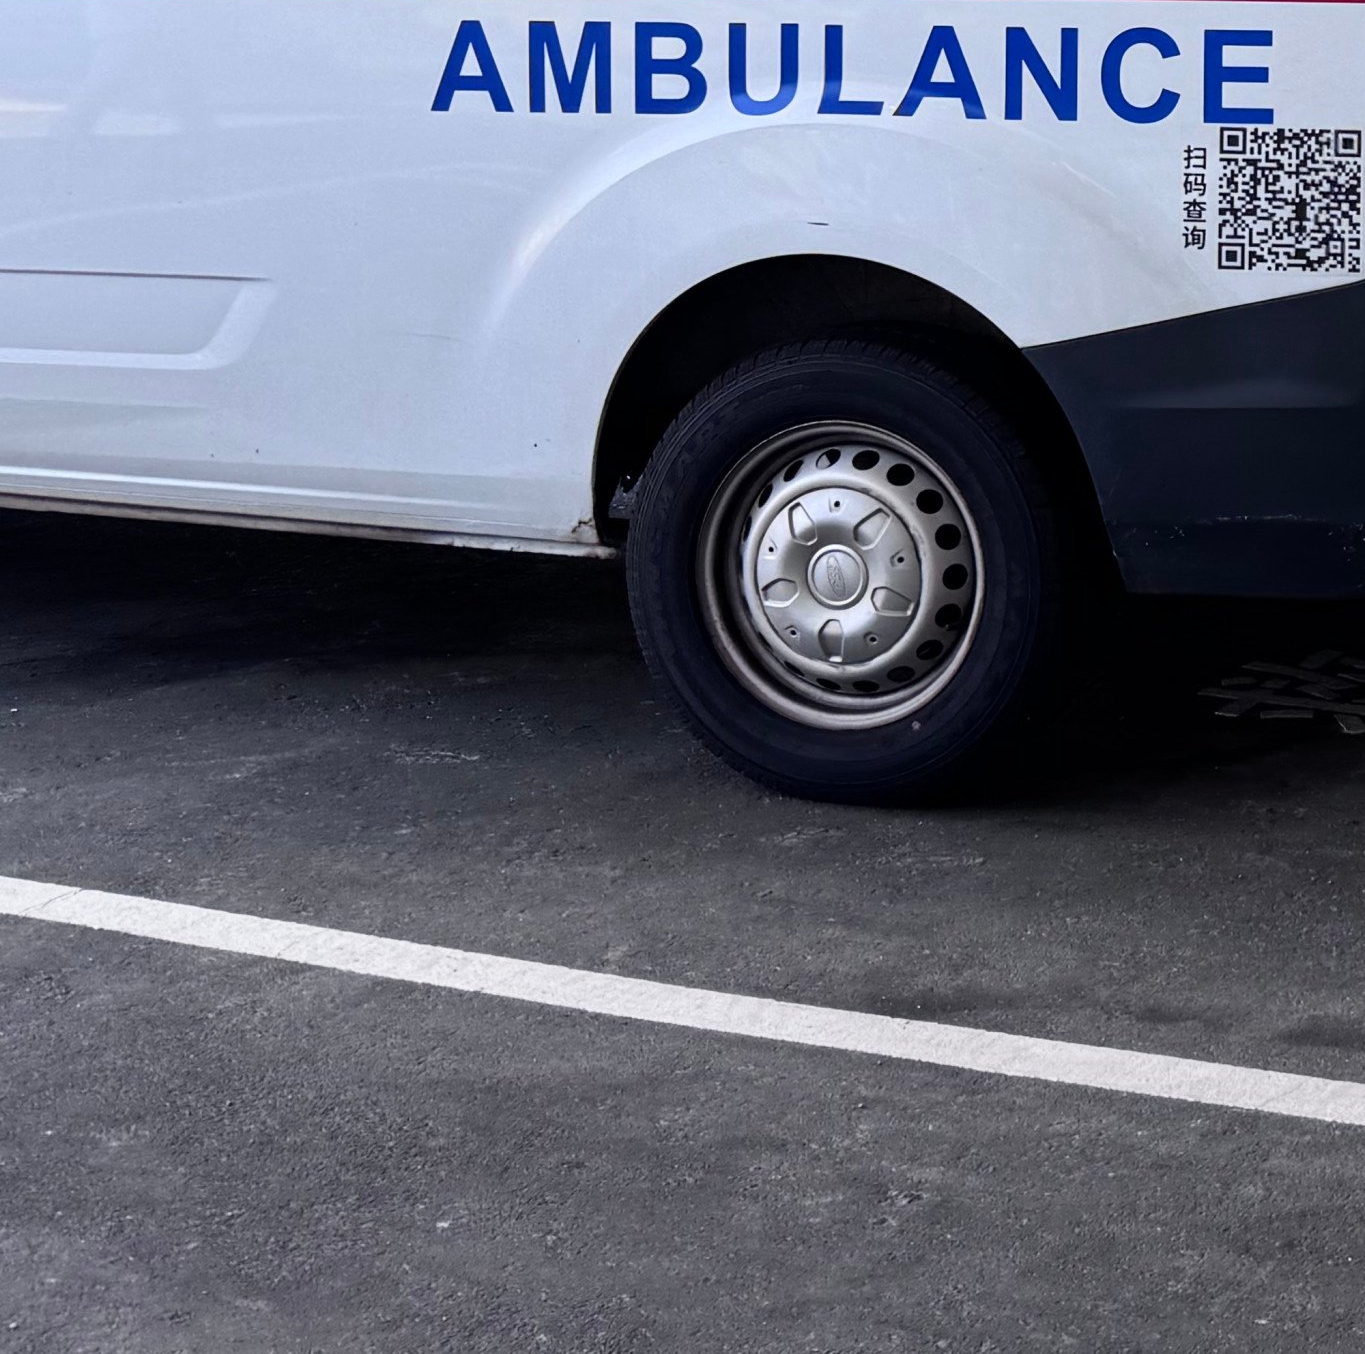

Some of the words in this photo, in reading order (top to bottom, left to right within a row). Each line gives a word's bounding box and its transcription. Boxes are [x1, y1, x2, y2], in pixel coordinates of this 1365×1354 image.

[431, 19, 1275, 125] AMBULANCE
[1182, 145, 1207, 250] 扫码查询
